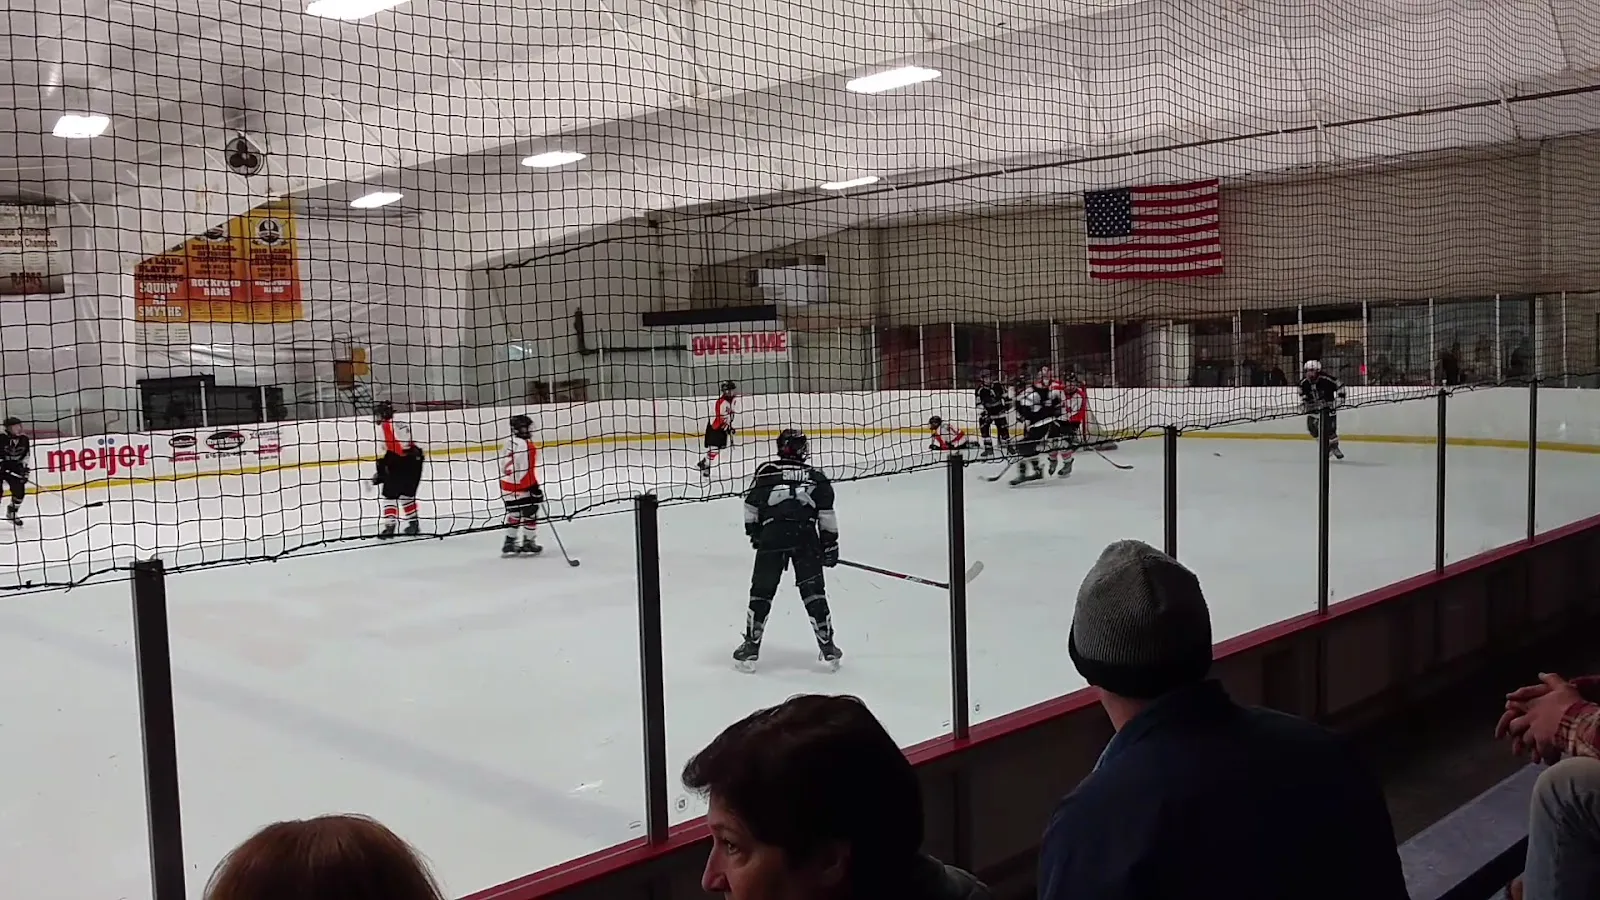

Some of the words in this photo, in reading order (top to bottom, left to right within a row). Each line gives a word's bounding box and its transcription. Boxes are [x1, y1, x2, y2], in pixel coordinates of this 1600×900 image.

[139, 282, 178, 294] SQUIRT
[191, 278, 241, 287] ROCKFORD
[203, 287, 231, 296] RAMS
[137, 306, 182, 317] SMYTHE
[692, 333, 786, 356] OVERTIME
[47, 438, 149, 476] meijer
